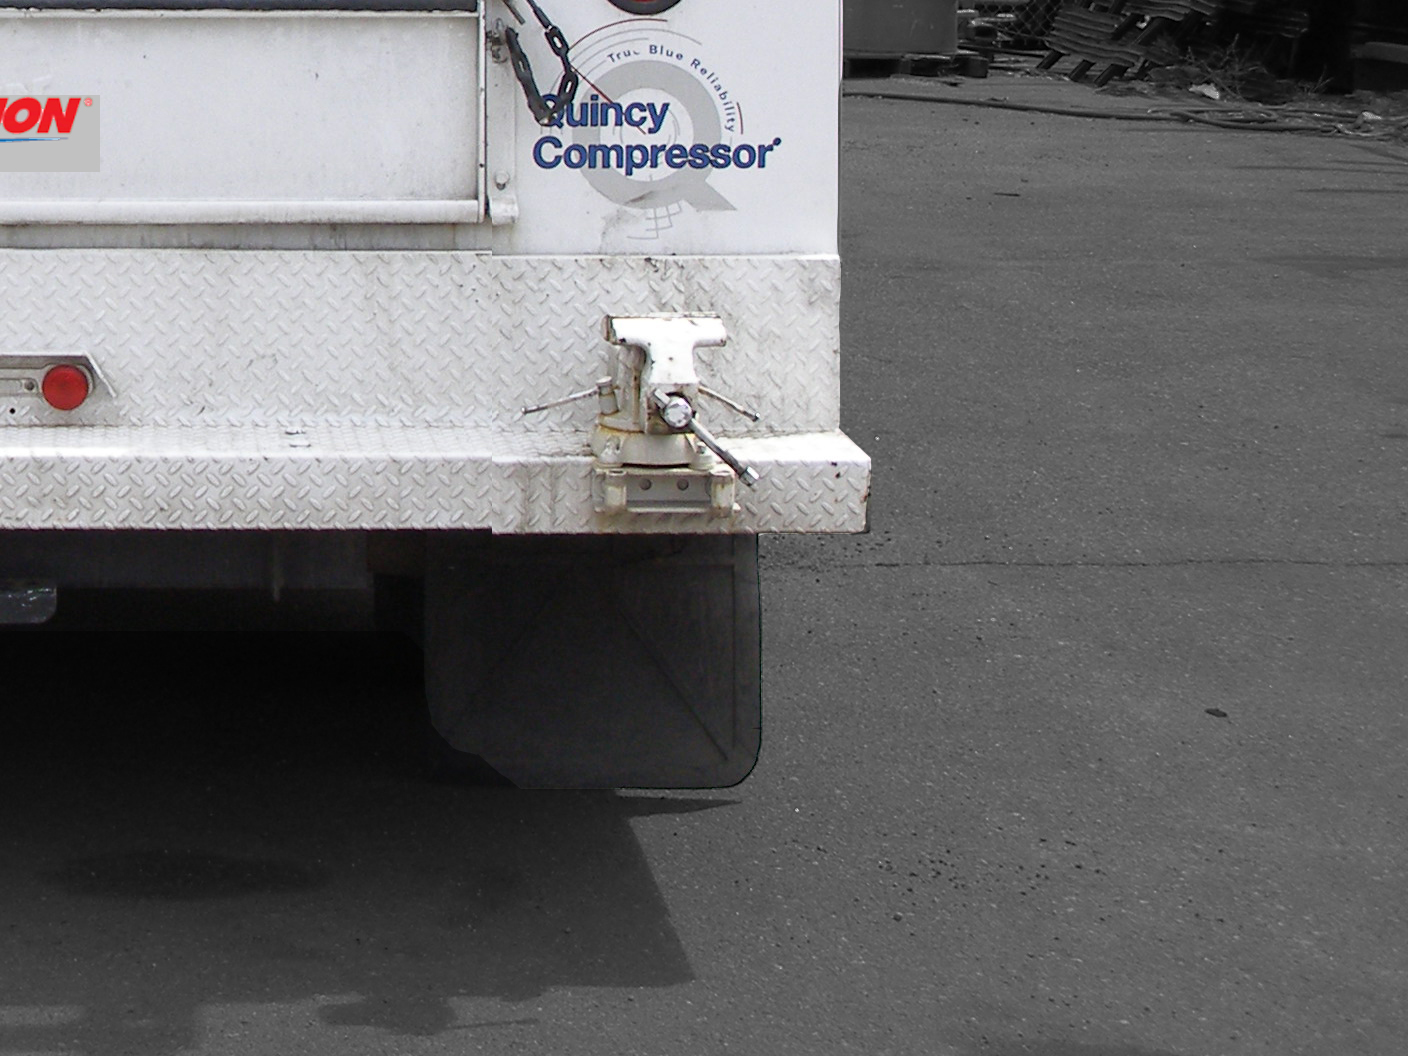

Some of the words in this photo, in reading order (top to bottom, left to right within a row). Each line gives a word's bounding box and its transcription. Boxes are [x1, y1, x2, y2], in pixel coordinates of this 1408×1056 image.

[649, 44, 683, 61] Blue
[690, 58, 736, 133] Reliability
[533, 135, 775, 176] Compressor
